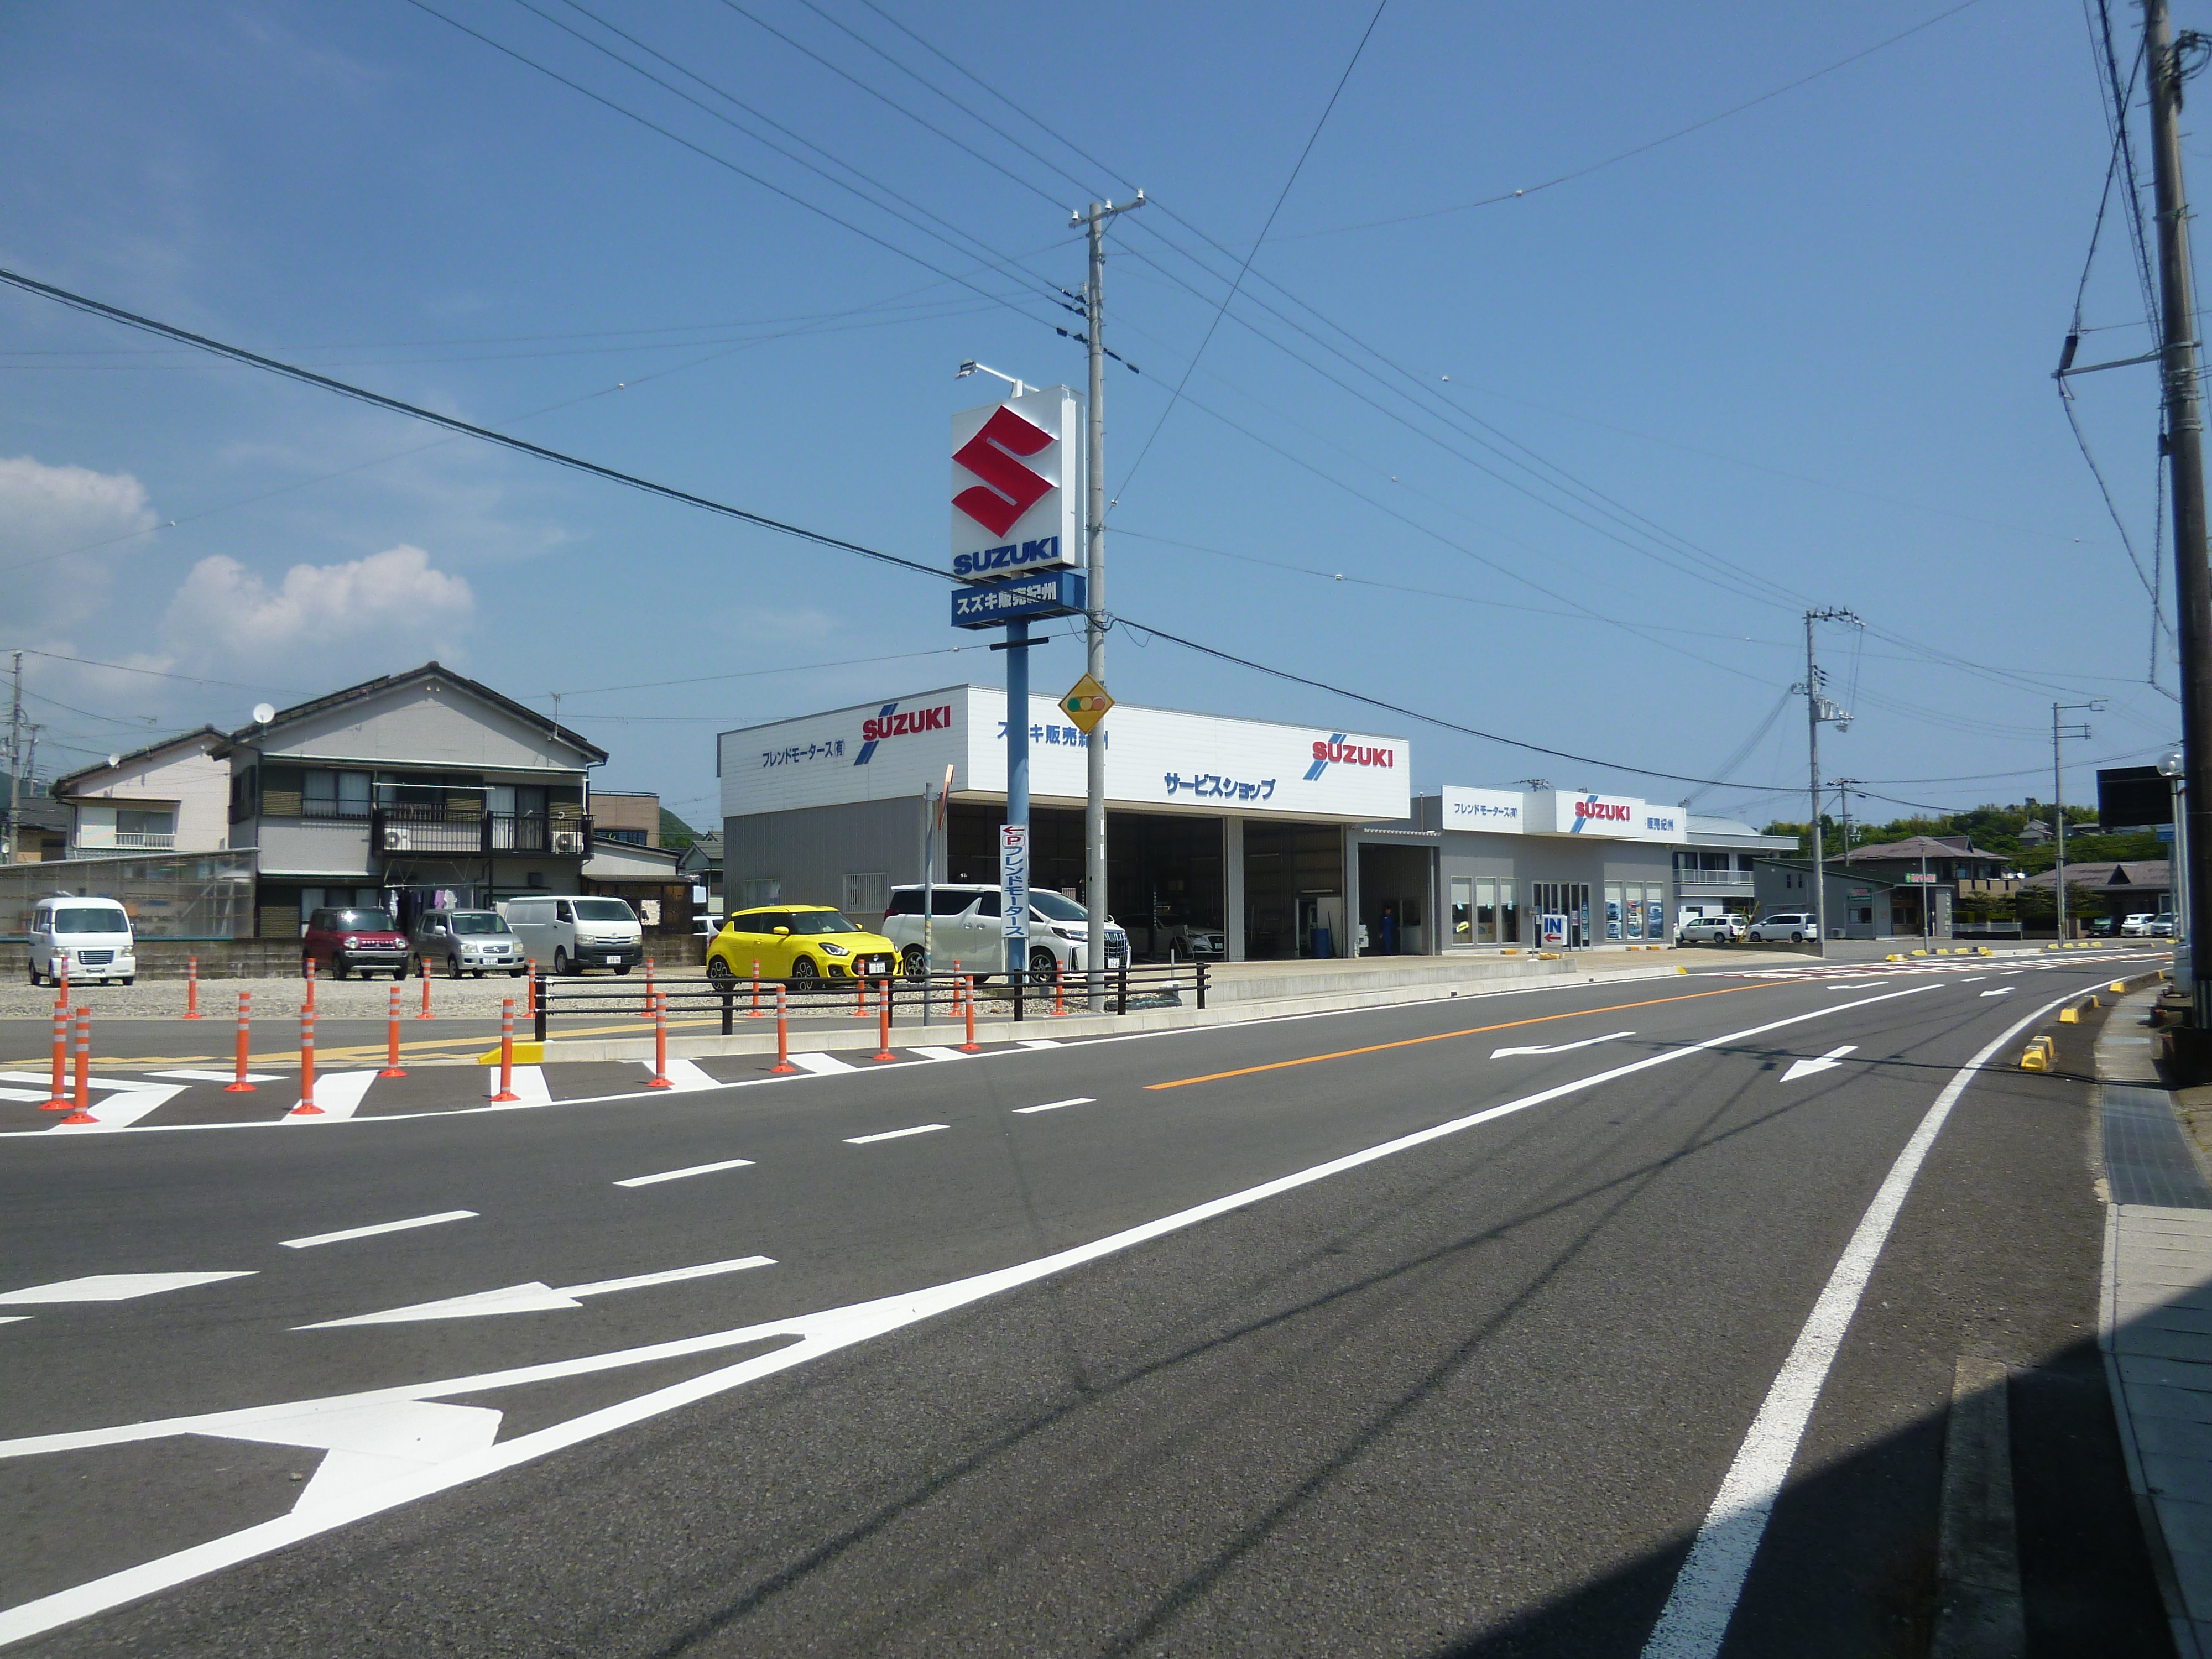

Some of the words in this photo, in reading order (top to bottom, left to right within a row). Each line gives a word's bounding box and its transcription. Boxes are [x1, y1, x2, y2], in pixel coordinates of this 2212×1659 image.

[953, 536, 1059, 575] SUZUKI
[957, 581, 1056, 615] スズキ販売紀州
[863, 706, 951, 742] SUZUKI
[1312, 740, 1394, 768] SUZUKI
[1164, 772, 1276, 800] サービスショップ
[1574, 801, 1631, 821] SUZUKI
[1006, 836, 1021, 846] P
[1004, 846, 1024, 936] フレンドモータース
[1544, 917, 1562, 933] IN
